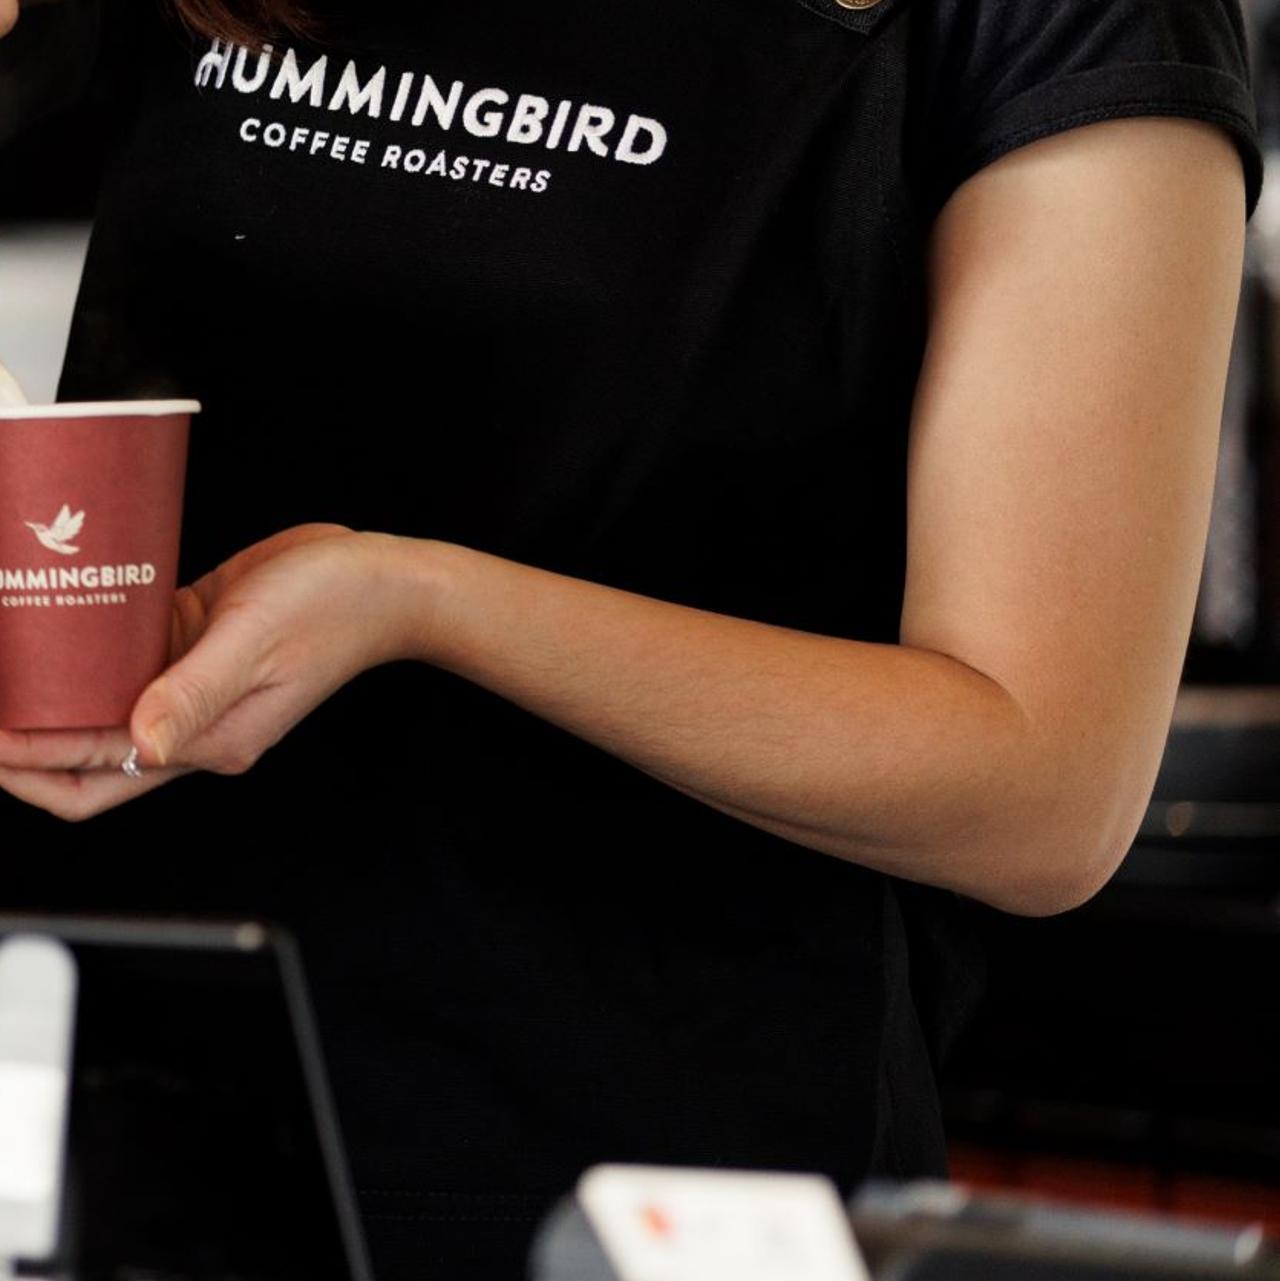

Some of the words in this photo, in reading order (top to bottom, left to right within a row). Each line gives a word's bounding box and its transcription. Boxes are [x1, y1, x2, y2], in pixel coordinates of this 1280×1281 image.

[193, 36, 668, 166] HUMMINGBIRD
[239, 117, 371, 164] COFFEE
[380, 144, 552, 194] ROASTERS
[1, 593, 51, 608] COFFEE
[55, 592, 127, 607] ROASTERS
